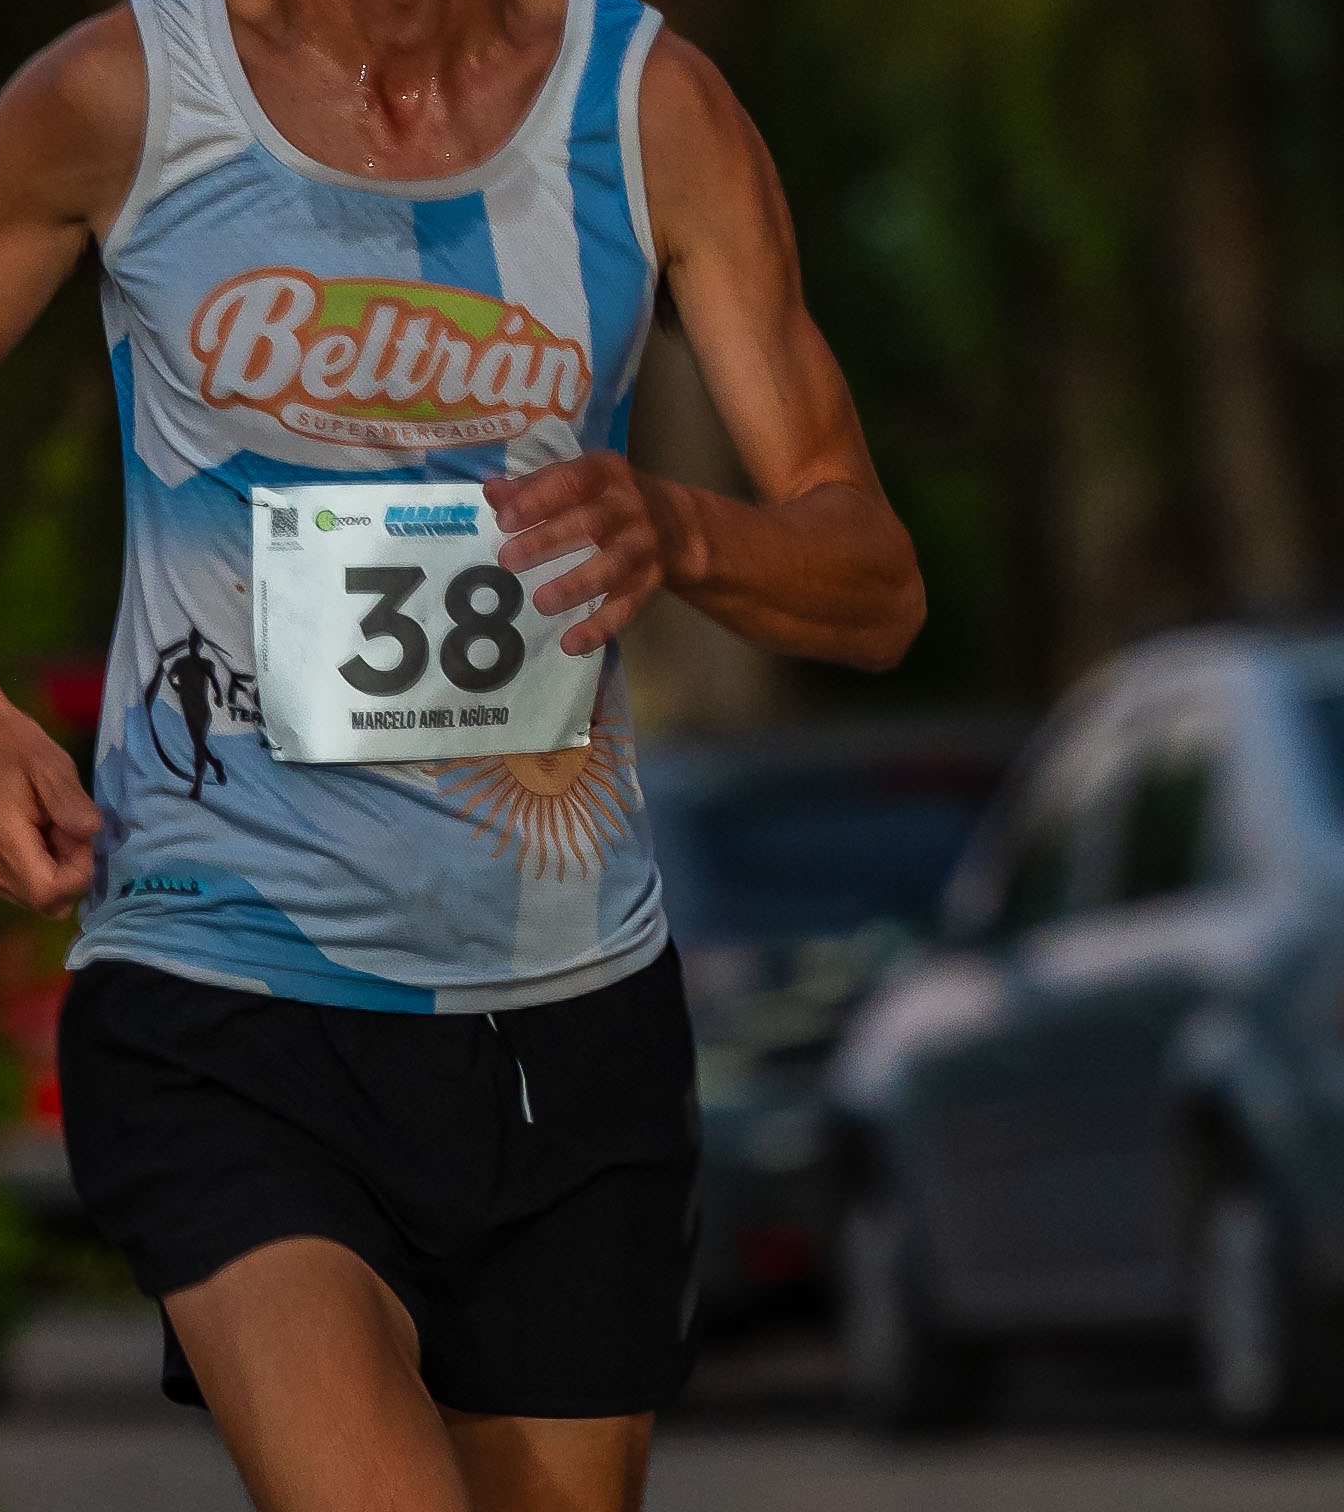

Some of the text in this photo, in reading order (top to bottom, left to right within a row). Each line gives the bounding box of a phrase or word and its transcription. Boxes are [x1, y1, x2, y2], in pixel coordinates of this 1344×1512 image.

[197, 274, 584, 413] Beltrán
[338, 564, 526, 697] 38
[351, 704, 510, 730] MARCELO ARIEL AGÜERO
